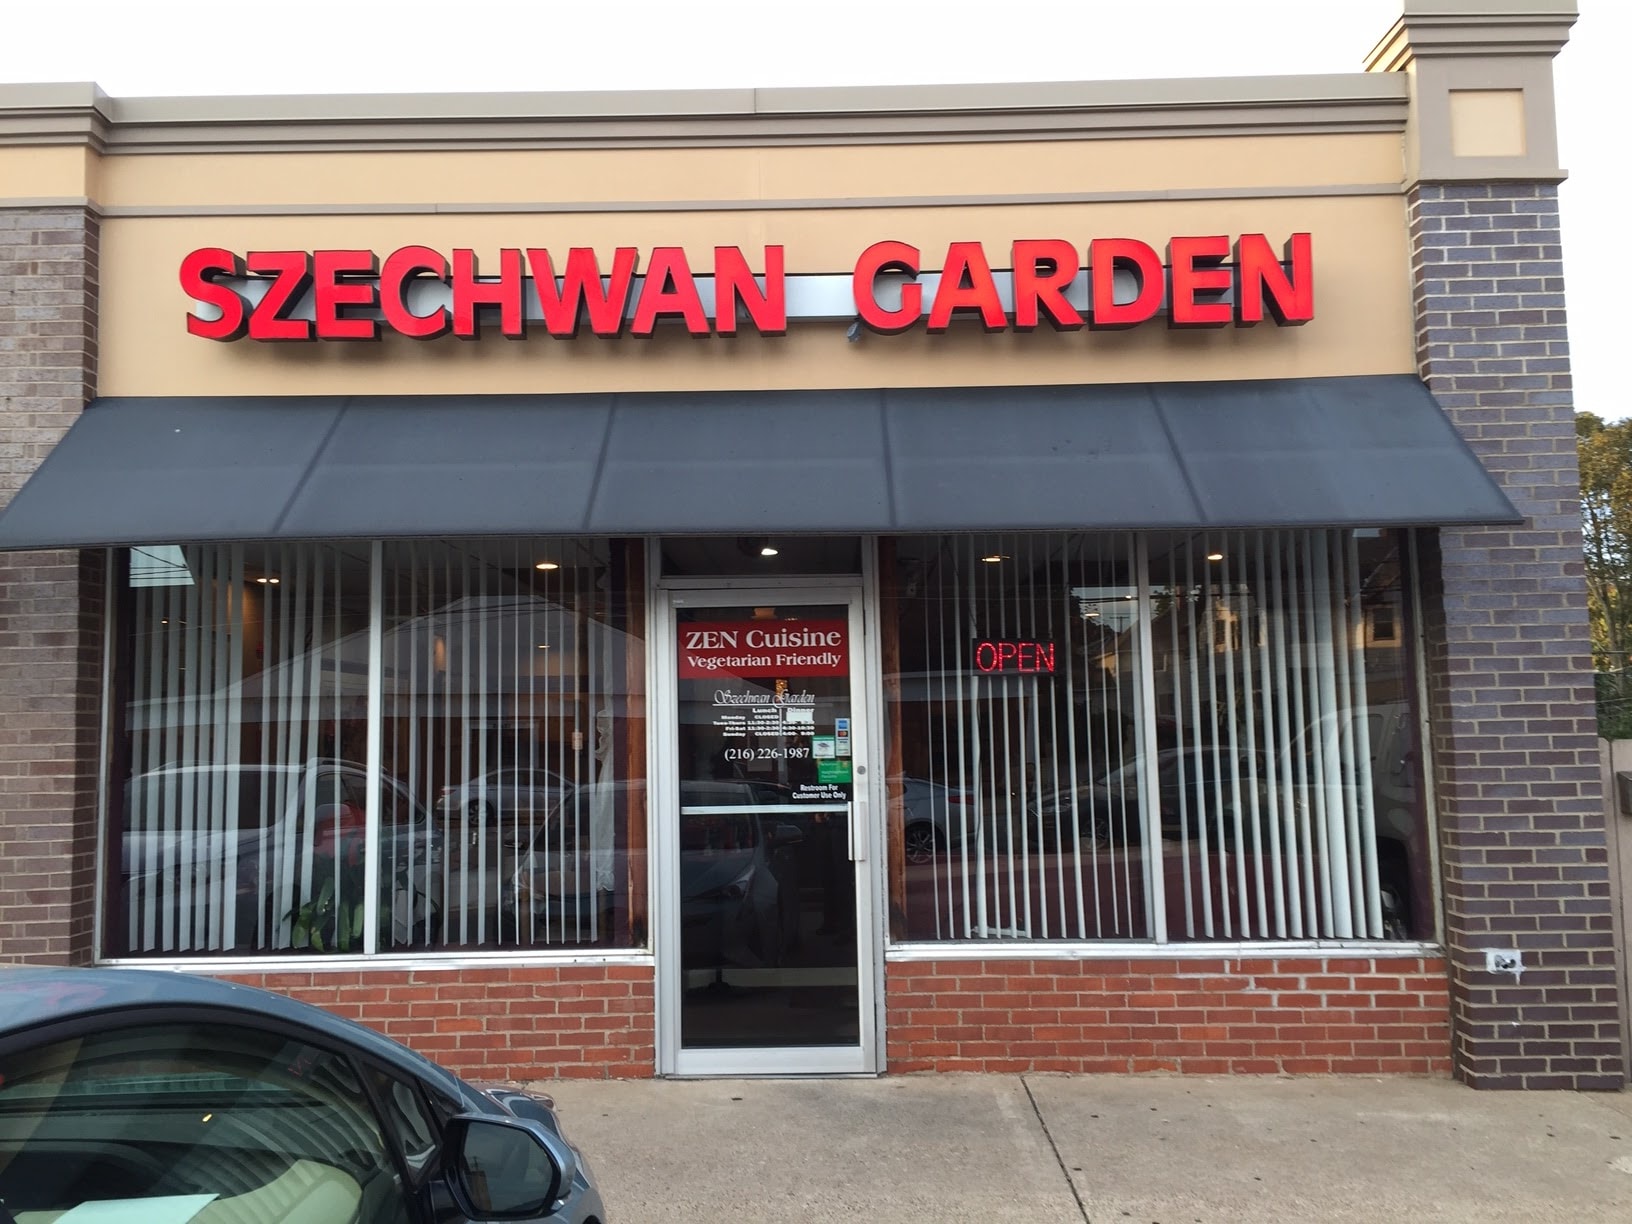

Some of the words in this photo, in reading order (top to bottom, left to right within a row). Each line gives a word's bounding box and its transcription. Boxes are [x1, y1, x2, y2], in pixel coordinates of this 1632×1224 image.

[179, 244, 787, 341] SZECHWAN
[852, 232, 1314, 334] GARDEN
[685, 630, 739, 650] ZEN
[745, 627, 842, 649] Cuisine
[687, 654, 772, 671] Vegetarian
[775, 652, 842, 668] Friendly
[976, 642, 1055, 673] OPEN
[724, 748, 755, 761] (216)
[757, 747, 810, 759] 226-1987
[832, 791, 847, 800] Only
